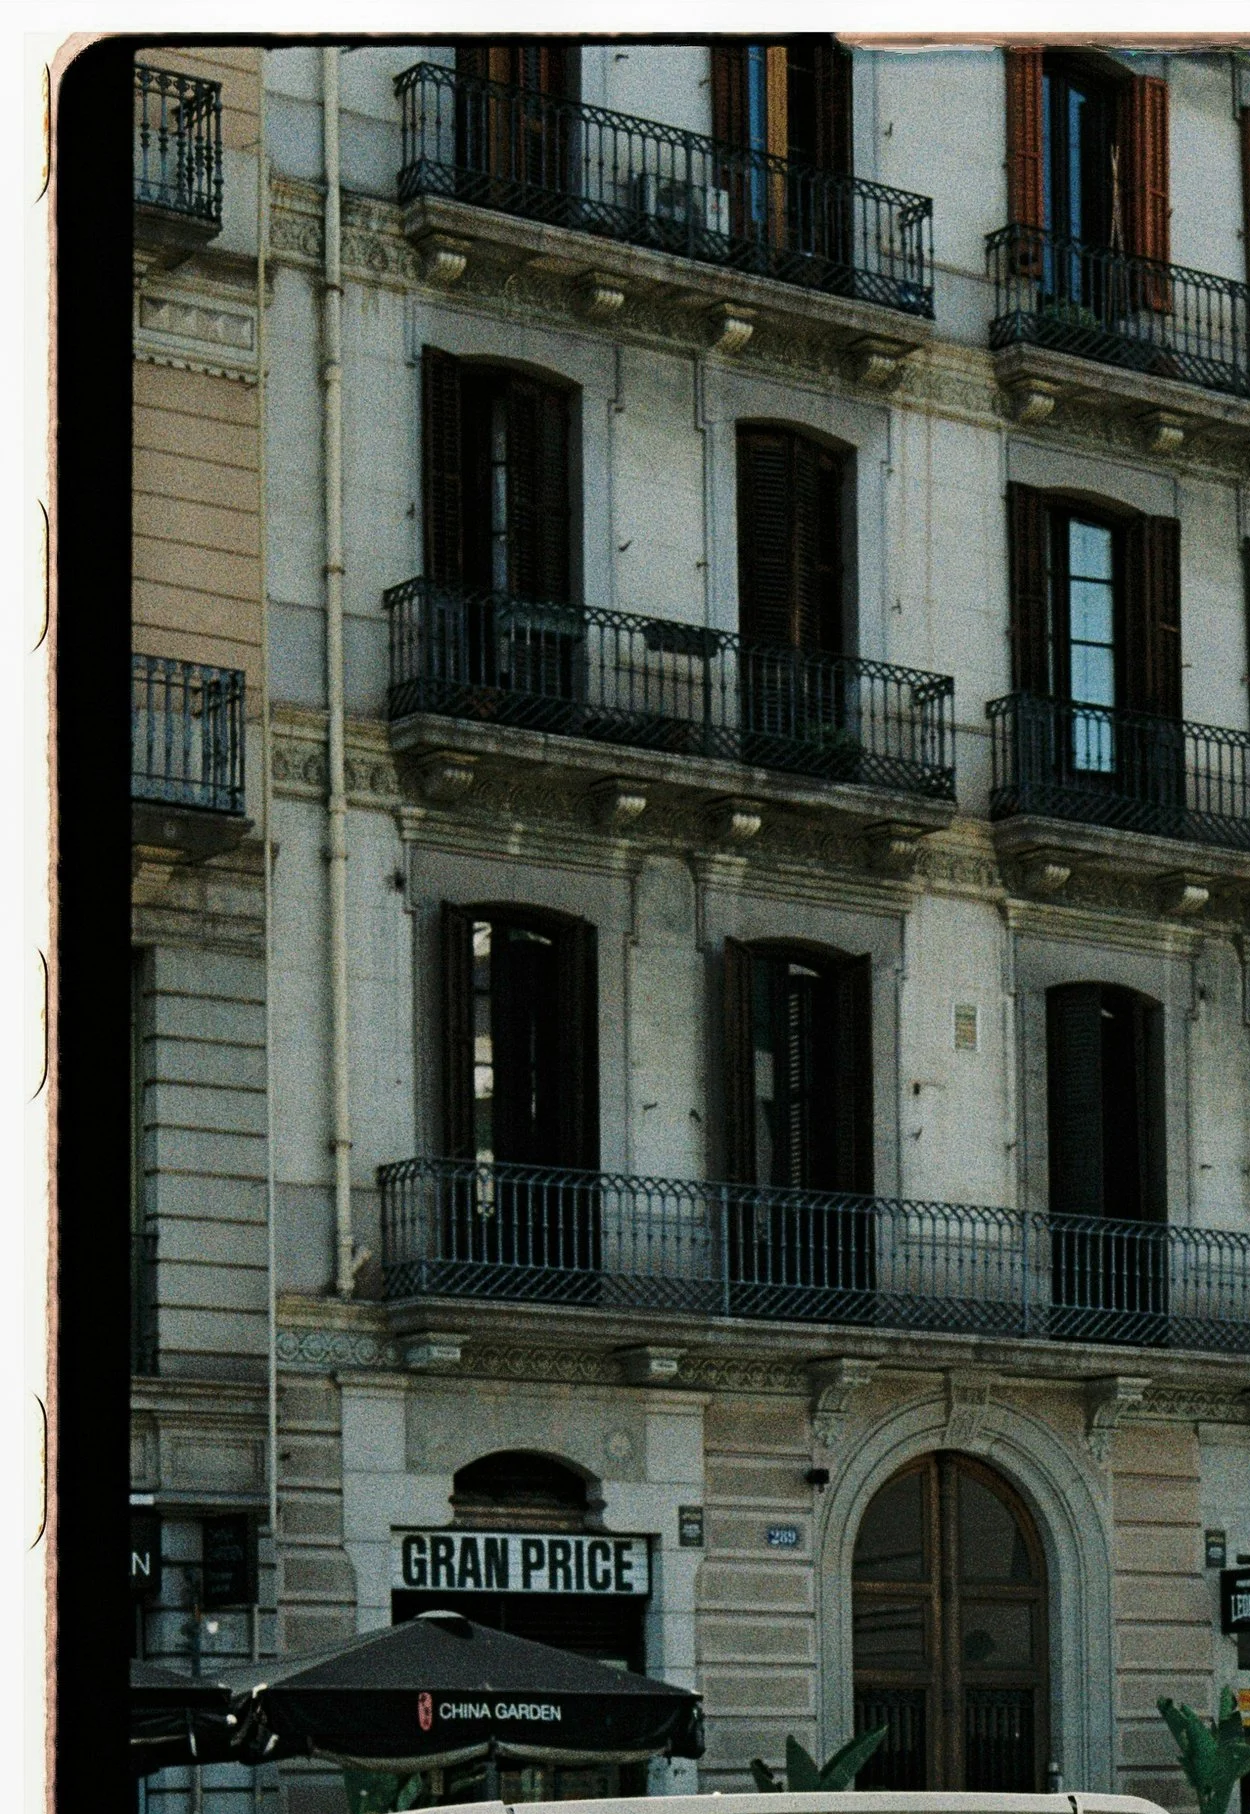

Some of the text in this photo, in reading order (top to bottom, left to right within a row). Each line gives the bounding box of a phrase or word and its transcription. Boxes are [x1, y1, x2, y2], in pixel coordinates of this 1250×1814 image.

[402, 1534, 633, 1591] GRAN PRICE
[439, 1702, 562, 1721] CHINA GARDEN
